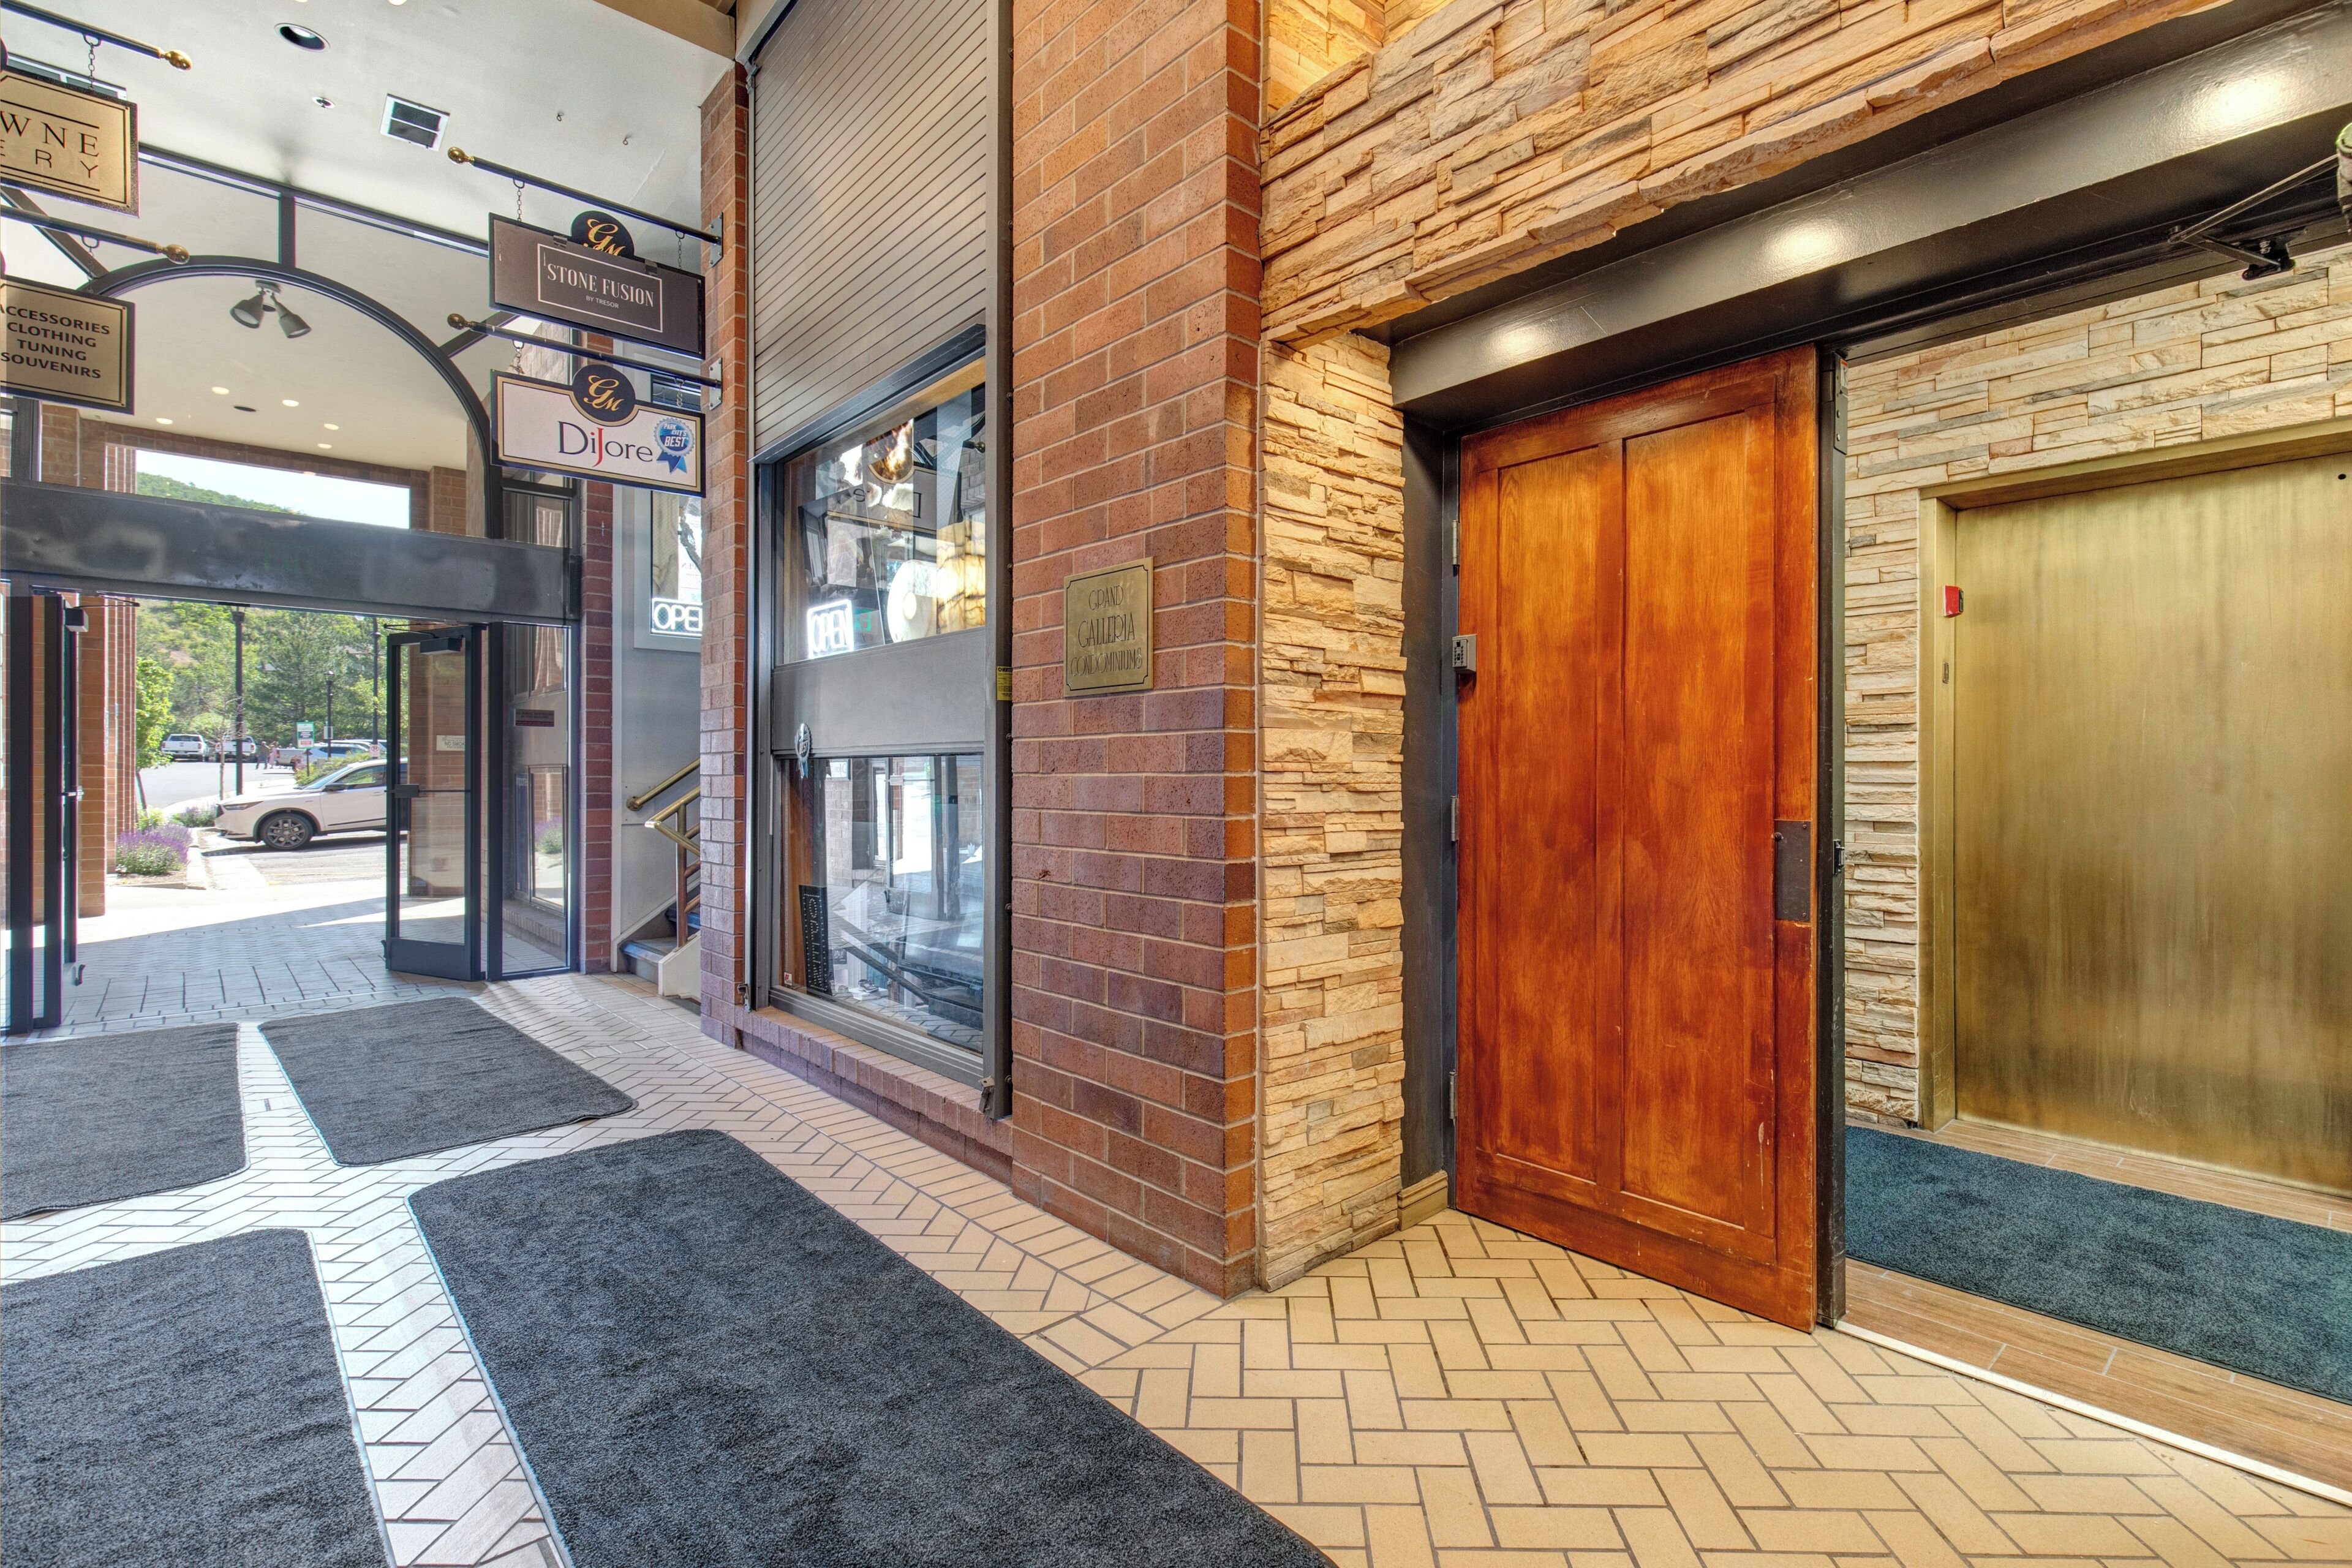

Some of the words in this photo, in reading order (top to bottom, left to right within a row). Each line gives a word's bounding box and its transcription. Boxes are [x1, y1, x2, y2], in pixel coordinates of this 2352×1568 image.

[548, 263, 597, 292] STONE
[602, 277, 654, 307] FUSION
[595, 298, 619, 309] TRESOR
[7, 322, 97, 347] CLOTHING
[17, 339, 86, 361] TUNING
[1, 352, 101, 379] SOUVENIRS
[557, 421, 653, 467] DiJore
[664, 435, 685, 447] BEST
[1088, 585, 1124, 611] GRAND
[1078, 611, 1135, 647] GALLERIA
[1070, 647, 1142, 677] CONDOMINIUMS
[809, 899, 822, 987] OPEN
